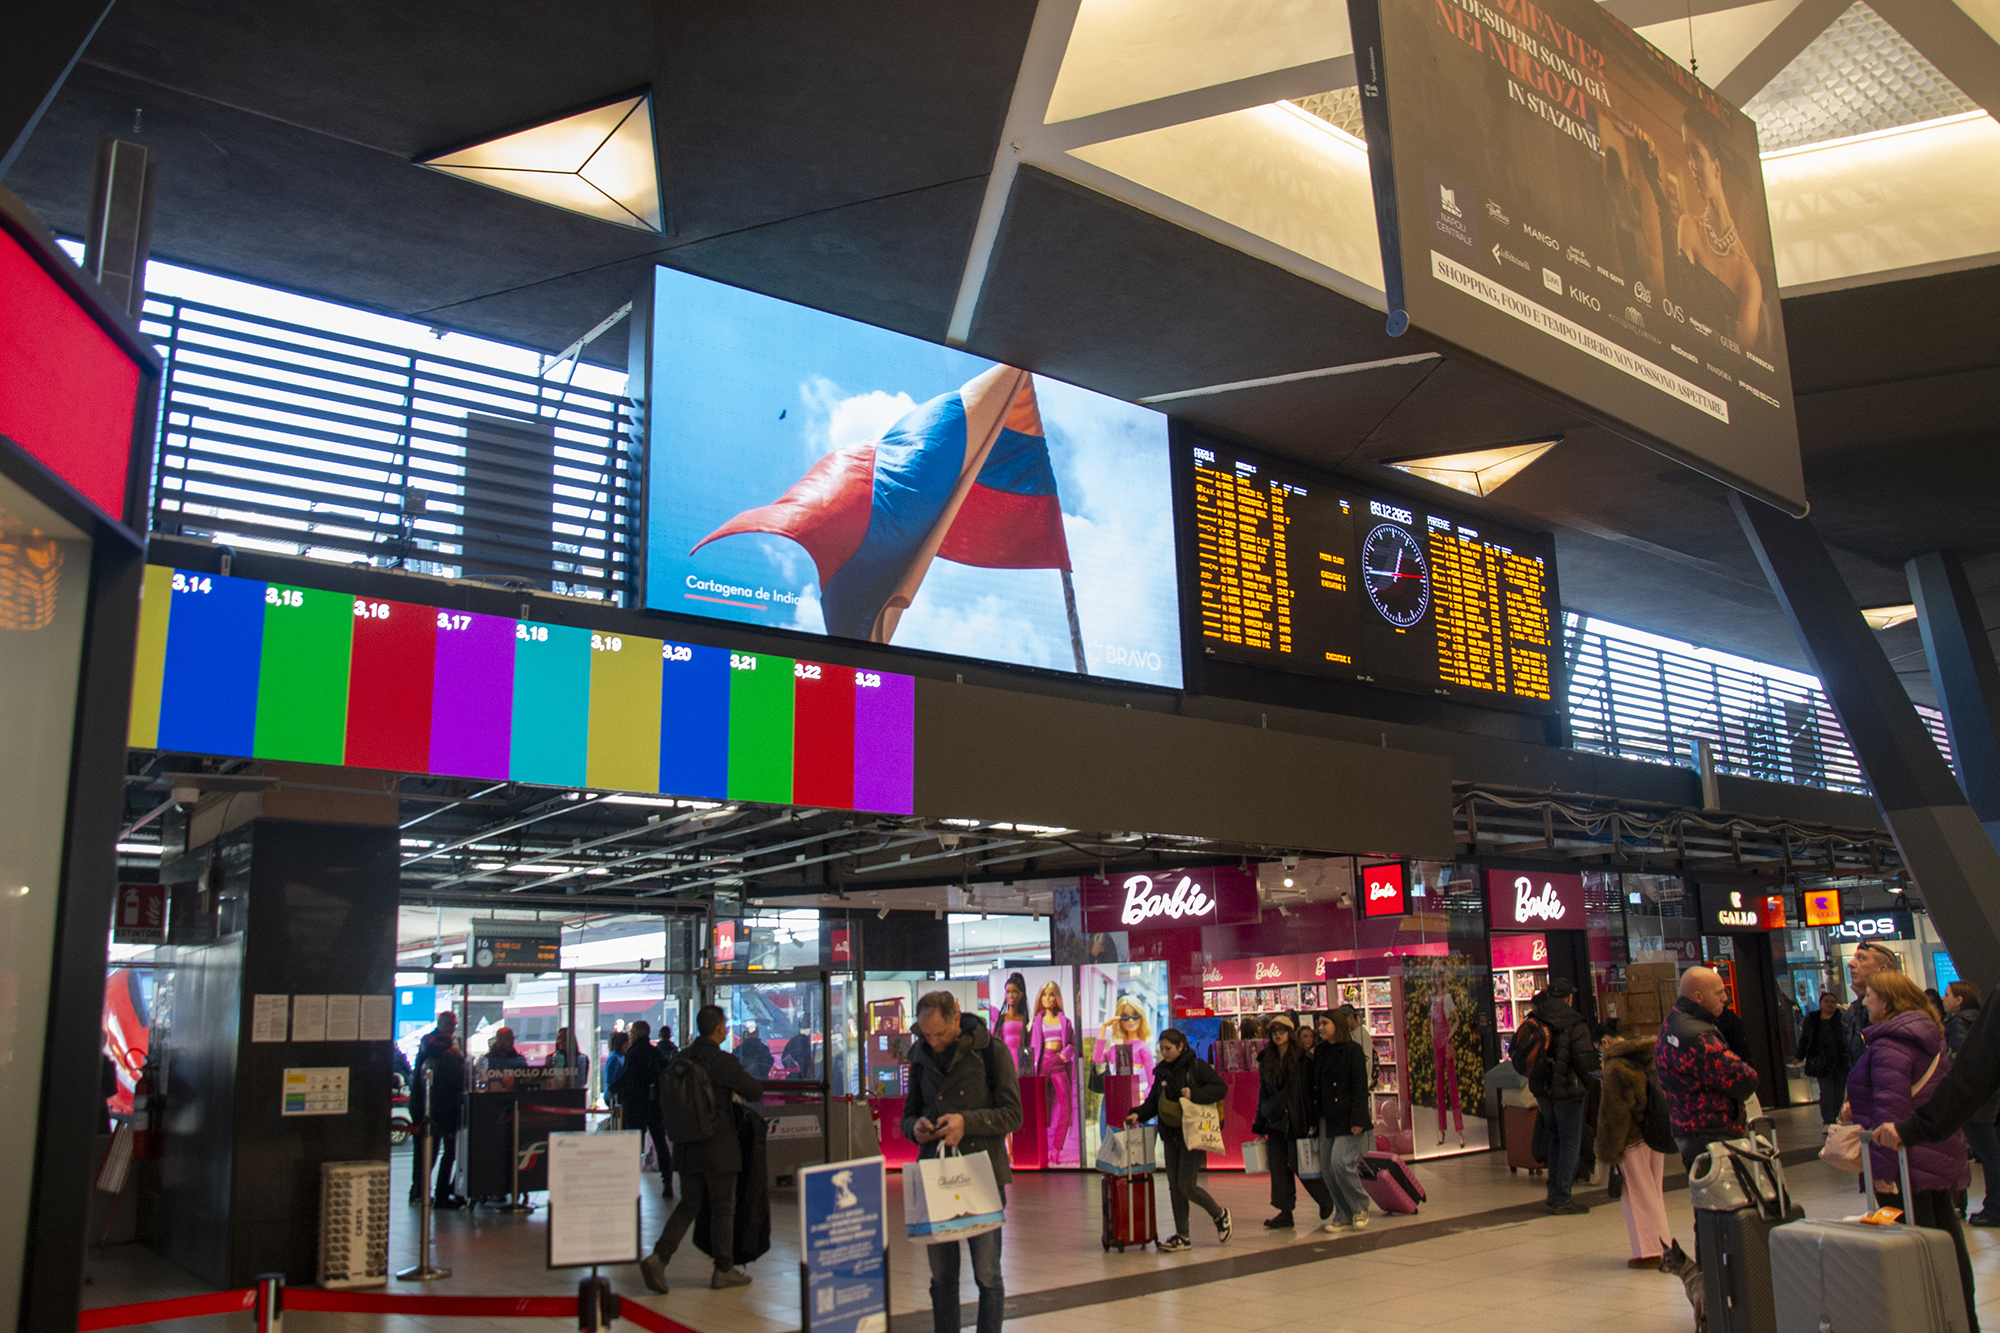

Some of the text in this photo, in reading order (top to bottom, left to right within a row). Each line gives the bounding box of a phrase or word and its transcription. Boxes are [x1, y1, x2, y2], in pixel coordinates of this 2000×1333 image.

[1436, 0, 1586, 120] NEI NEGOZI
[1461, 0, 1611, 107] DESIDERI SONO GIÀ
[1507, 79, 1606, 156] IN STAZIONE.
[1440, 212, 1467, 233] NAPOLI
[1435, 220, 1473, 247] CENTRALE
[1523, 223, 1560, 251] MANGO
[1569, 285, 1601, 312] KIKO
[1663, 298, 1685, 324] OVS
[1438, 260, 1500, 306] SHOPPING,
[1500, 289, 1533, 321] FOOD
[1533, 308, 1541, 325] E
[1541, 312, 1579, 344] TEMPO
[1578, 330, 1613, 360] LIBERO
[1613, 348, 1635, 370] NON
[1634, 358, 1676, 392] POSSONO
[1677, 380, 1726, 417] ASPETTARE.
[1720, 335, 1741, 355] GUESS
[1706, 362, 1733, 383] PANDORA
[1746, 351, 1775, 373] STARBUCKS
[171, 573, 212, 595] 3,14
[686, 575, 753, 598] Cartagena
[754, 586, 771, 601] de
[265, 587, 304, 607] 3,15
[353, 600, 390, 620] 3,16
[436, 612, 472, 631] 3,17
[516, 624, 548, 643] 3,18
[590, 635, 622, 653] 3,19
[662, 644, 692, 662] 3,20
[730, 654, 757, 671] 3,21
[1106, 644, 1161, 672] BRAVO
[794, 663, 821, 680] 3,22
[1121, 875, 1215, 926] Barbie
[1370, 882, 1397, 901] Barbie
[1514, 876, 1566, 923] Barbie
[1719, 910, 1758, 926] GALLO
[477, 939, 489, 948] 16
[1255, 961, 1282, 981] Barbie
[781, 1124, 821, 1134] SECURITY
[354, 1207, 364, 1238] CARTA
